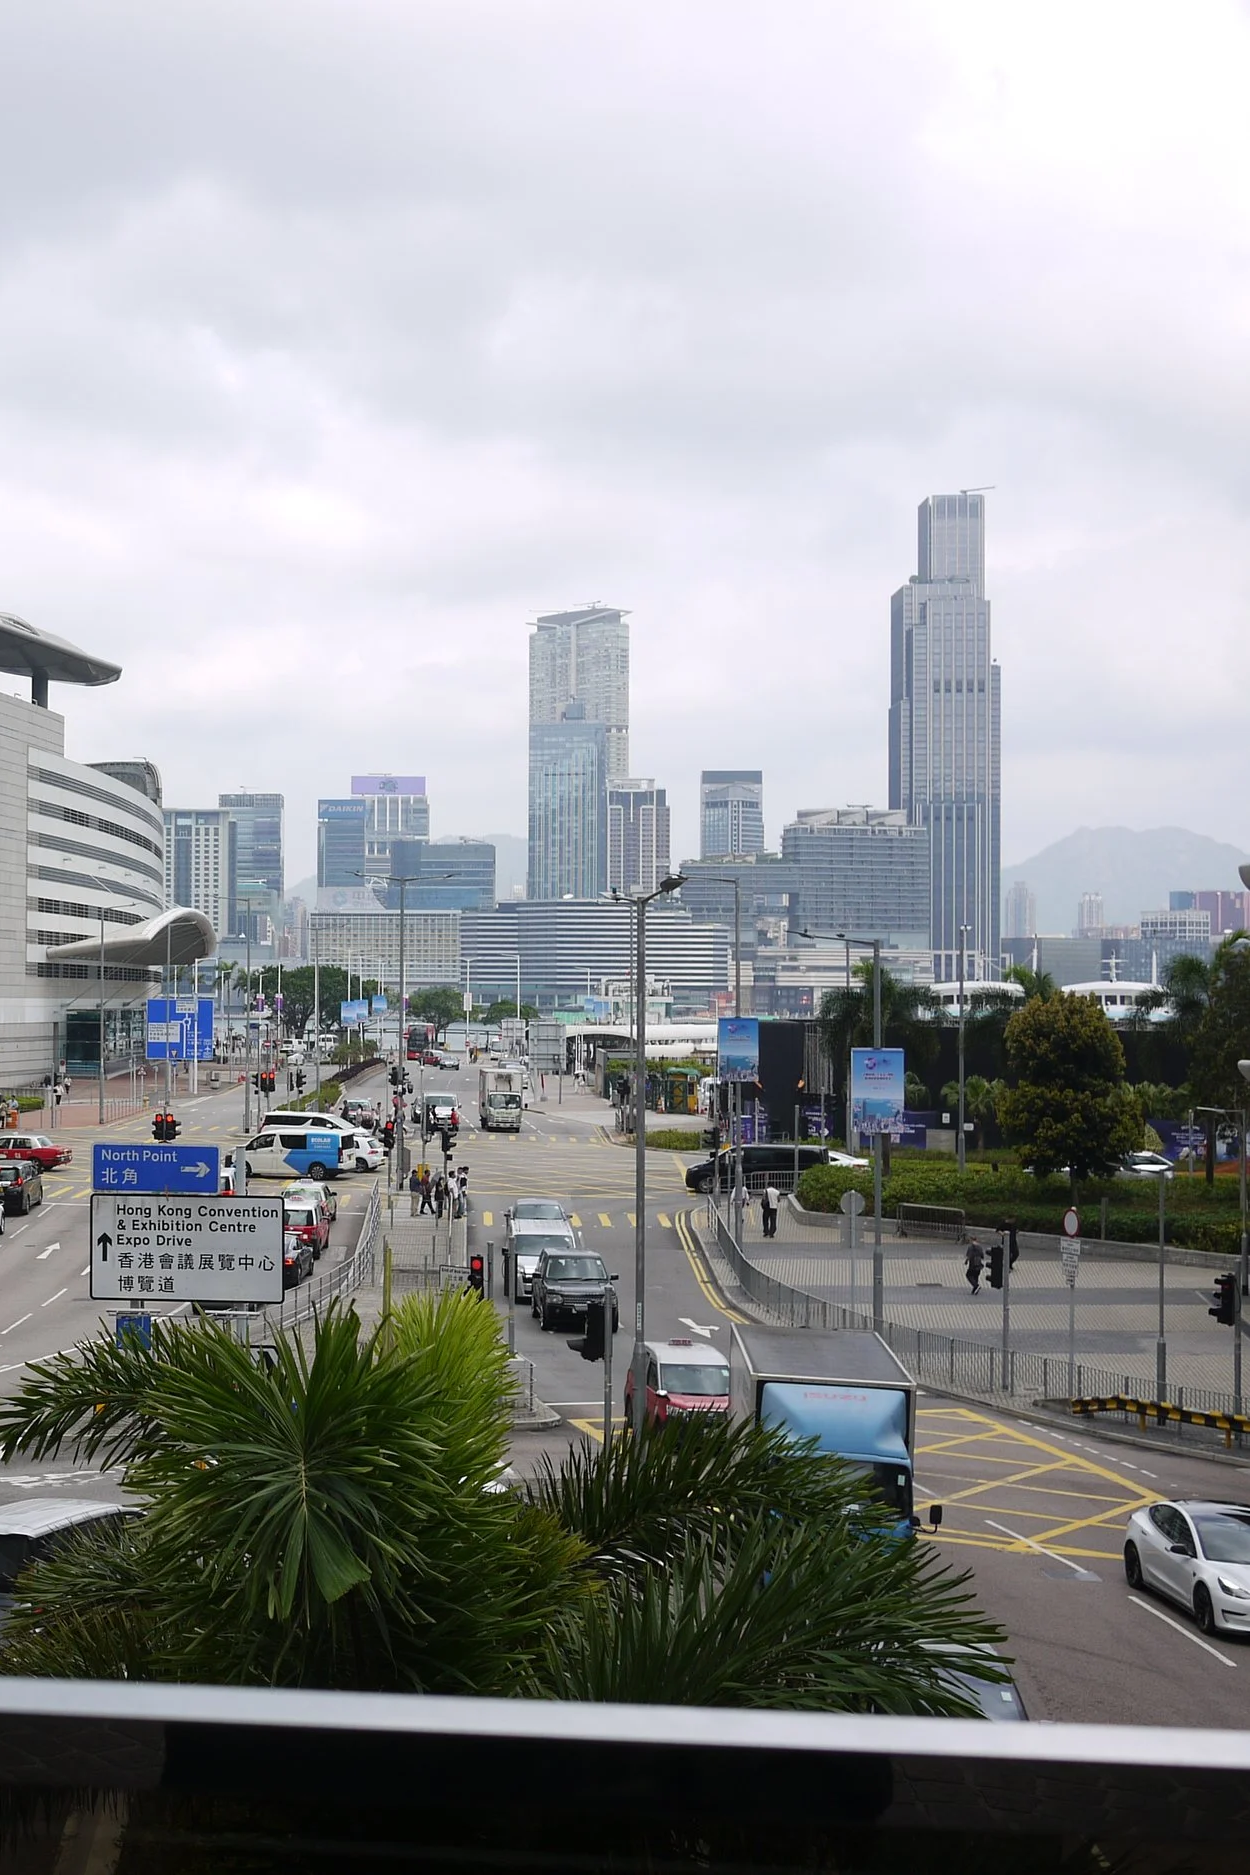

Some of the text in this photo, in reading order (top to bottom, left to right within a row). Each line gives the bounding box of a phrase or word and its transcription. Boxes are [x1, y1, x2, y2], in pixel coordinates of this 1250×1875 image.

[328, 805, 364, 813] DAIKIN
[101, 1149, 178, 1162] North Point
[101, 1167, 138, 1185] 北角
[116, 1204, 279, 1219] Hong Kong Convention
[116, 1219, 256, 1233] & Exhibition Centre
[116, 1235, 193, 1248] Expo Drive
[117, 1251, 276, 1272] 香港會議展覽中心
[117, 1275, 175, 1293] 博覽道
[803, 1392, 867, 1401] ISUZU
